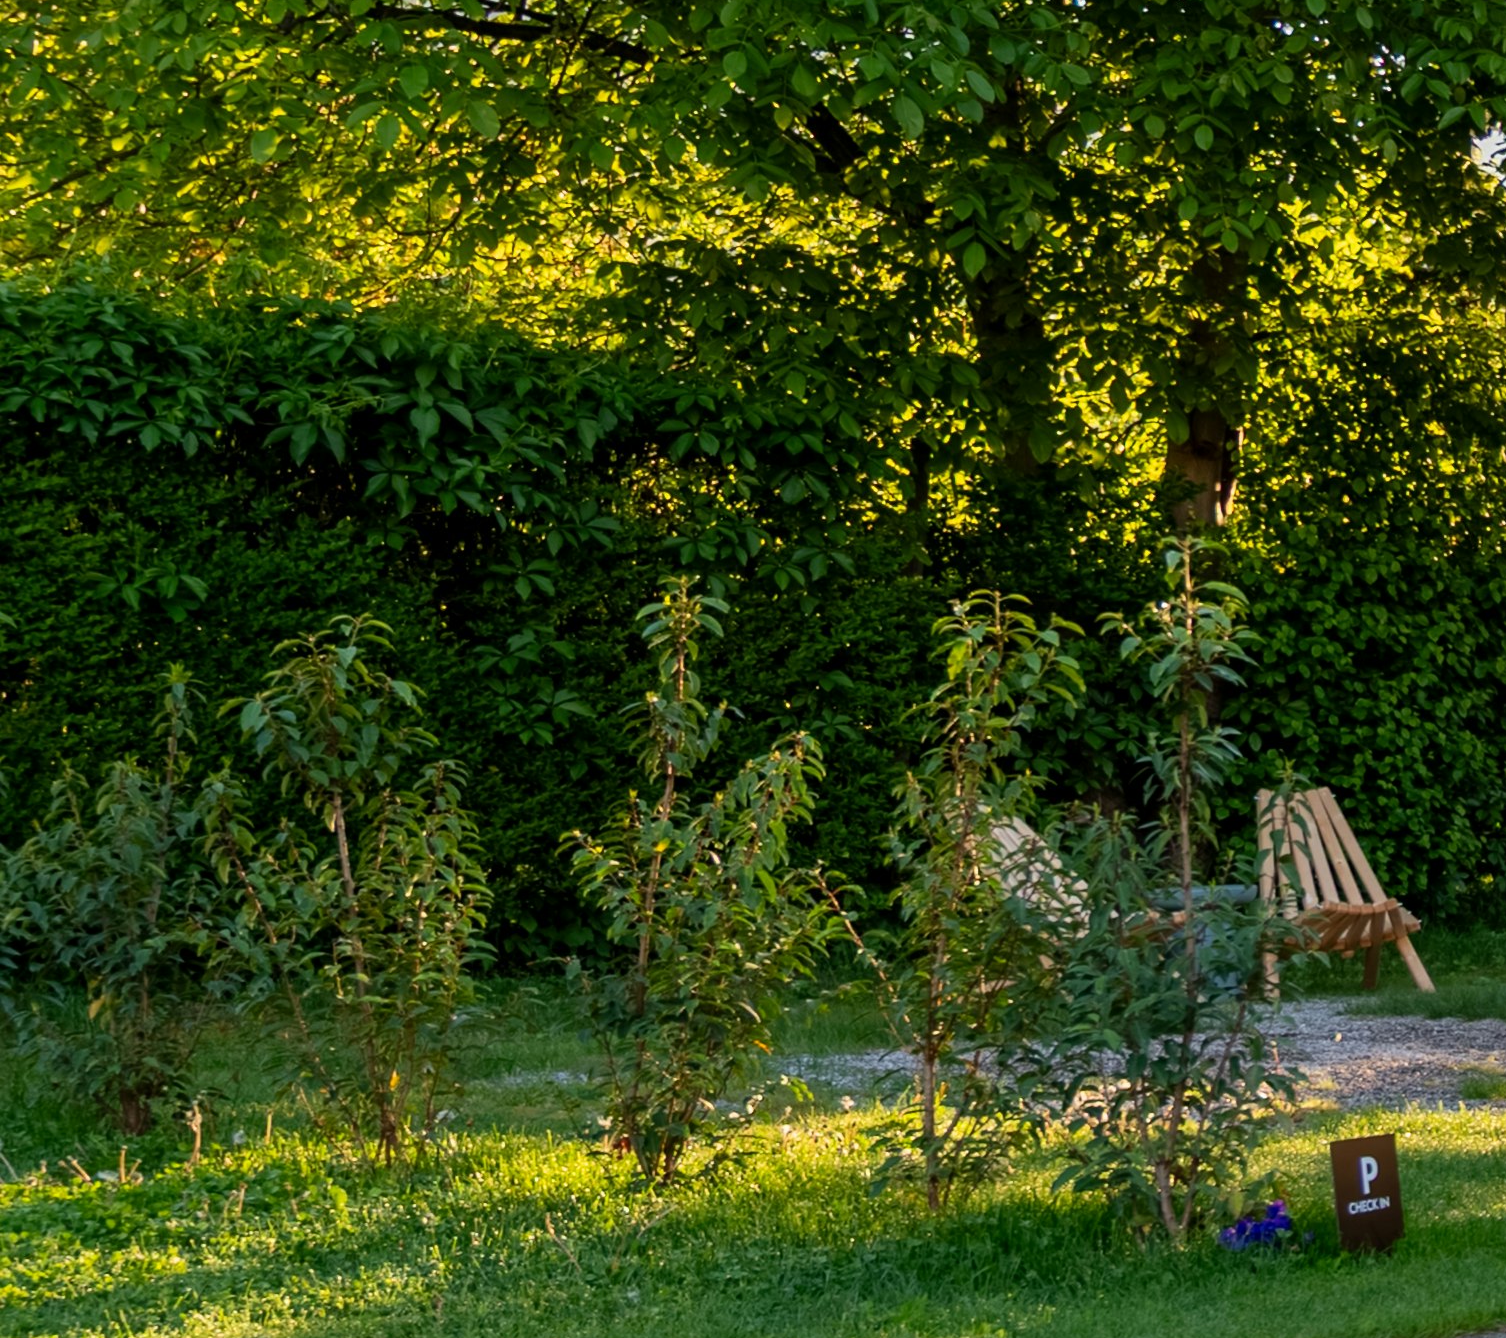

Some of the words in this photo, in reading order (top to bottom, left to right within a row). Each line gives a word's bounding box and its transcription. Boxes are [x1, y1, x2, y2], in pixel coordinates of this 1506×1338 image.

[1360, 1156, 1378, 1195] P
[1348, 1198, 1379, 1215] CHECK
[1380, 1196, 1390, 1209] IN
